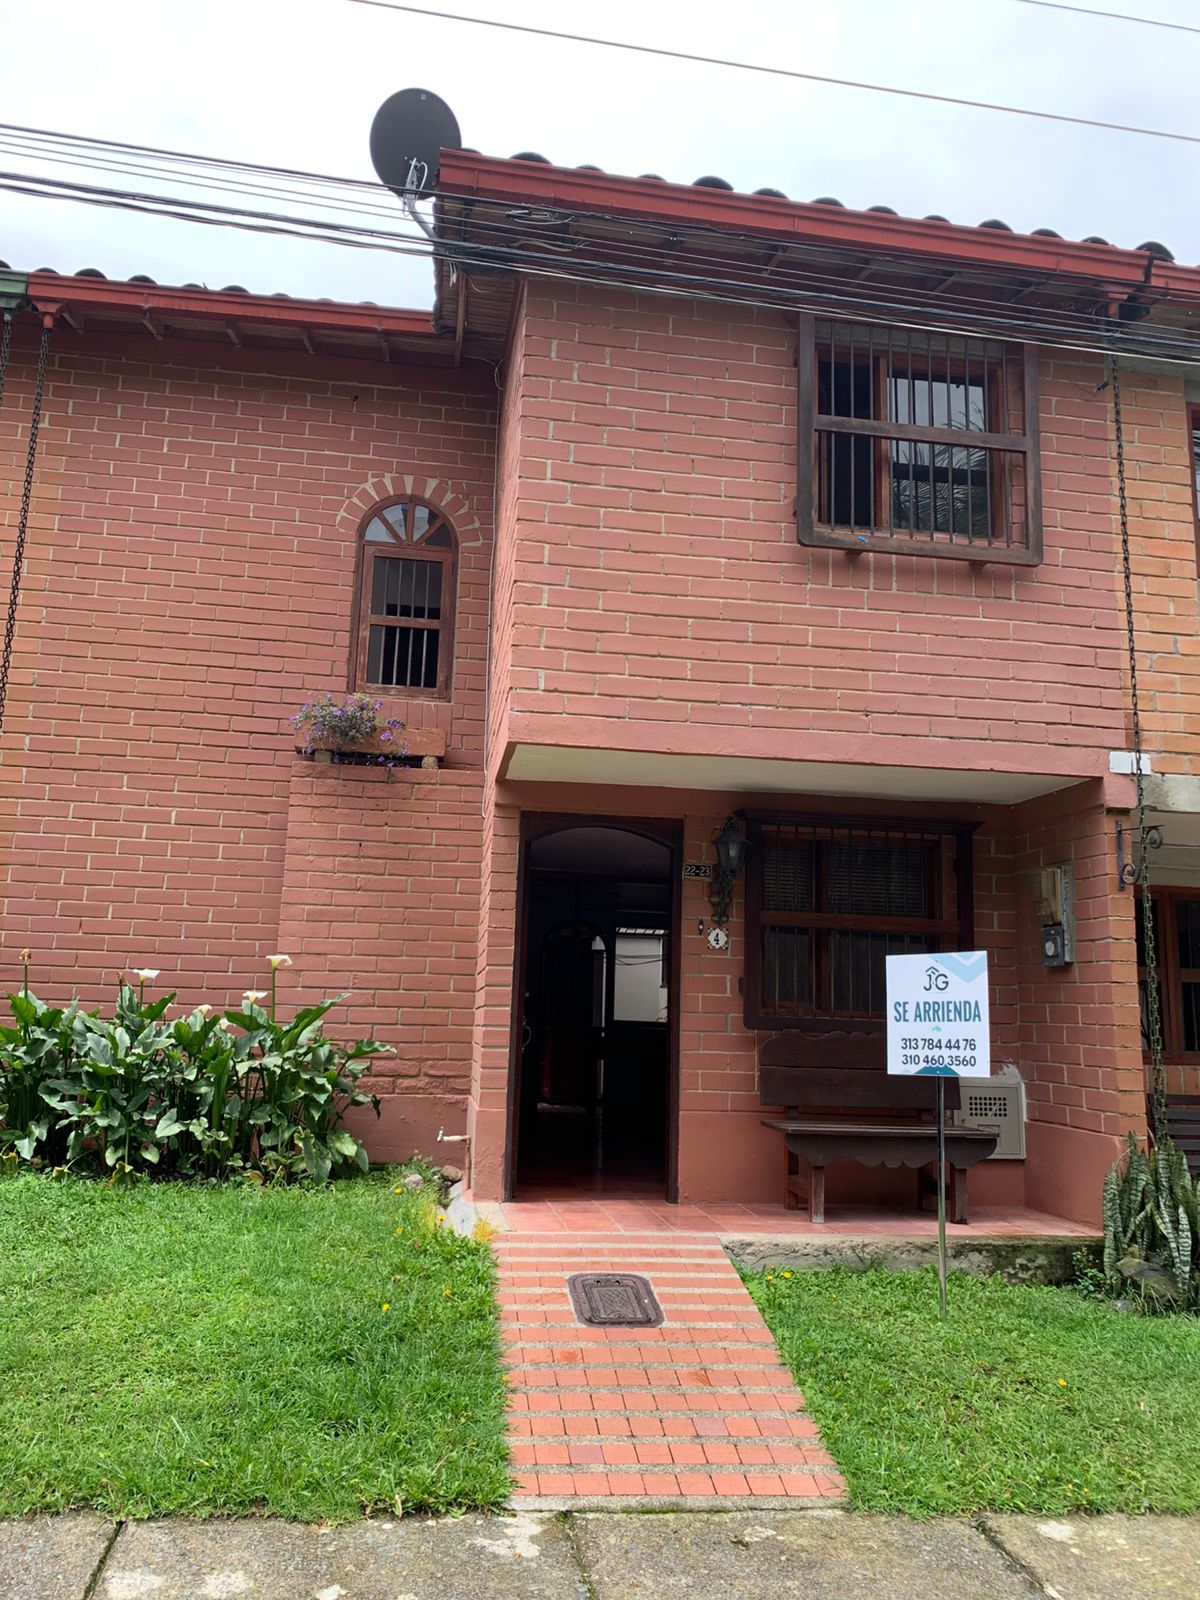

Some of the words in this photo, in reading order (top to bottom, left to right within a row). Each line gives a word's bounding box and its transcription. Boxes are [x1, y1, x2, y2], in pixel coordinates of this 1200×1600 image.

[685, 867, 710, 876] 22-23
[714, 933, 720, 945] 4
[894, 1002, 909, 1022] SE
[914, 1000, 981, 1022] ARRIENDA
[901, 1038, 919, 1050] 313
[921, 1038, 942, 1051] 784
[902, 1055, 920, 1065] 310
[922, 1055, 945, 1066] 460
[947, 1056, 976, 1067] 3560
